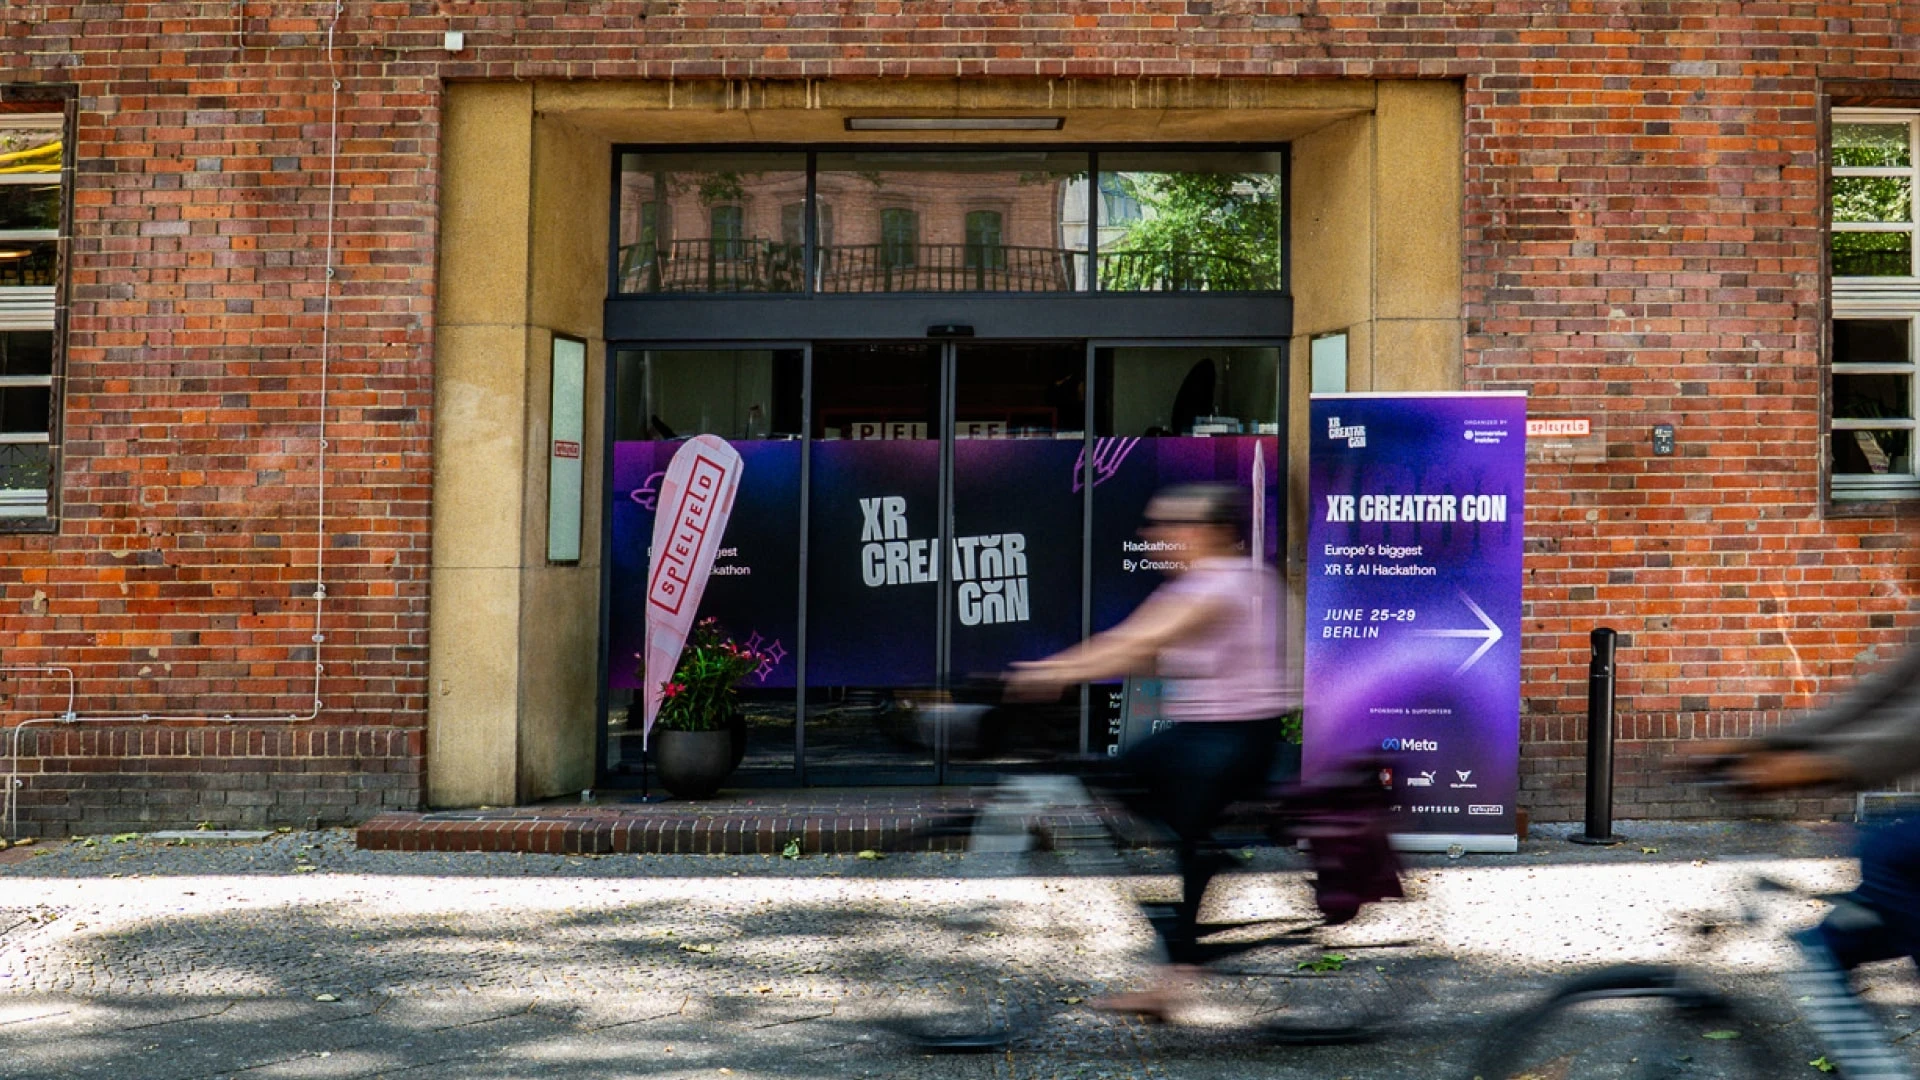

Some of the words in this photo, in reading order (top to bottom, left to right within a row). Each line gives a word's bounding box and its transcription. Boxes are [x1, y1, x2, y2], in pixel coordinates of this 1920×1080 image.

[1531, 420, 1584, 433] SPIELFELD
[1326, 495, 1355, 522] XR
[1360, 495, 1456, 522] CREATOR
[1462, 495, 1507, 522] CON
[859, 496, 908, 542] XR
[660, 474, 712, 595] SPIELFELD
[1324, 544, 1376, 558] Europe's
[1378, 544, 1423, 558] biggest
[1123, 559, 1138, 572] By
[1325, 564, 1341, 575] XR
[1344, 564, 1354, 576] &
[1357, 564, 1370, 575] AI
[1373, 564, 1437, 576] Hackathon
[1323, 609, 1363, 621] JUNE
[1369, 609, 1416, 621] 25-29
[1322, 626, 1379, 638] BERLIN
[1401, 738, 1438, 751] Meta
[1411, 805, 1460, 813] SOFTSEED
